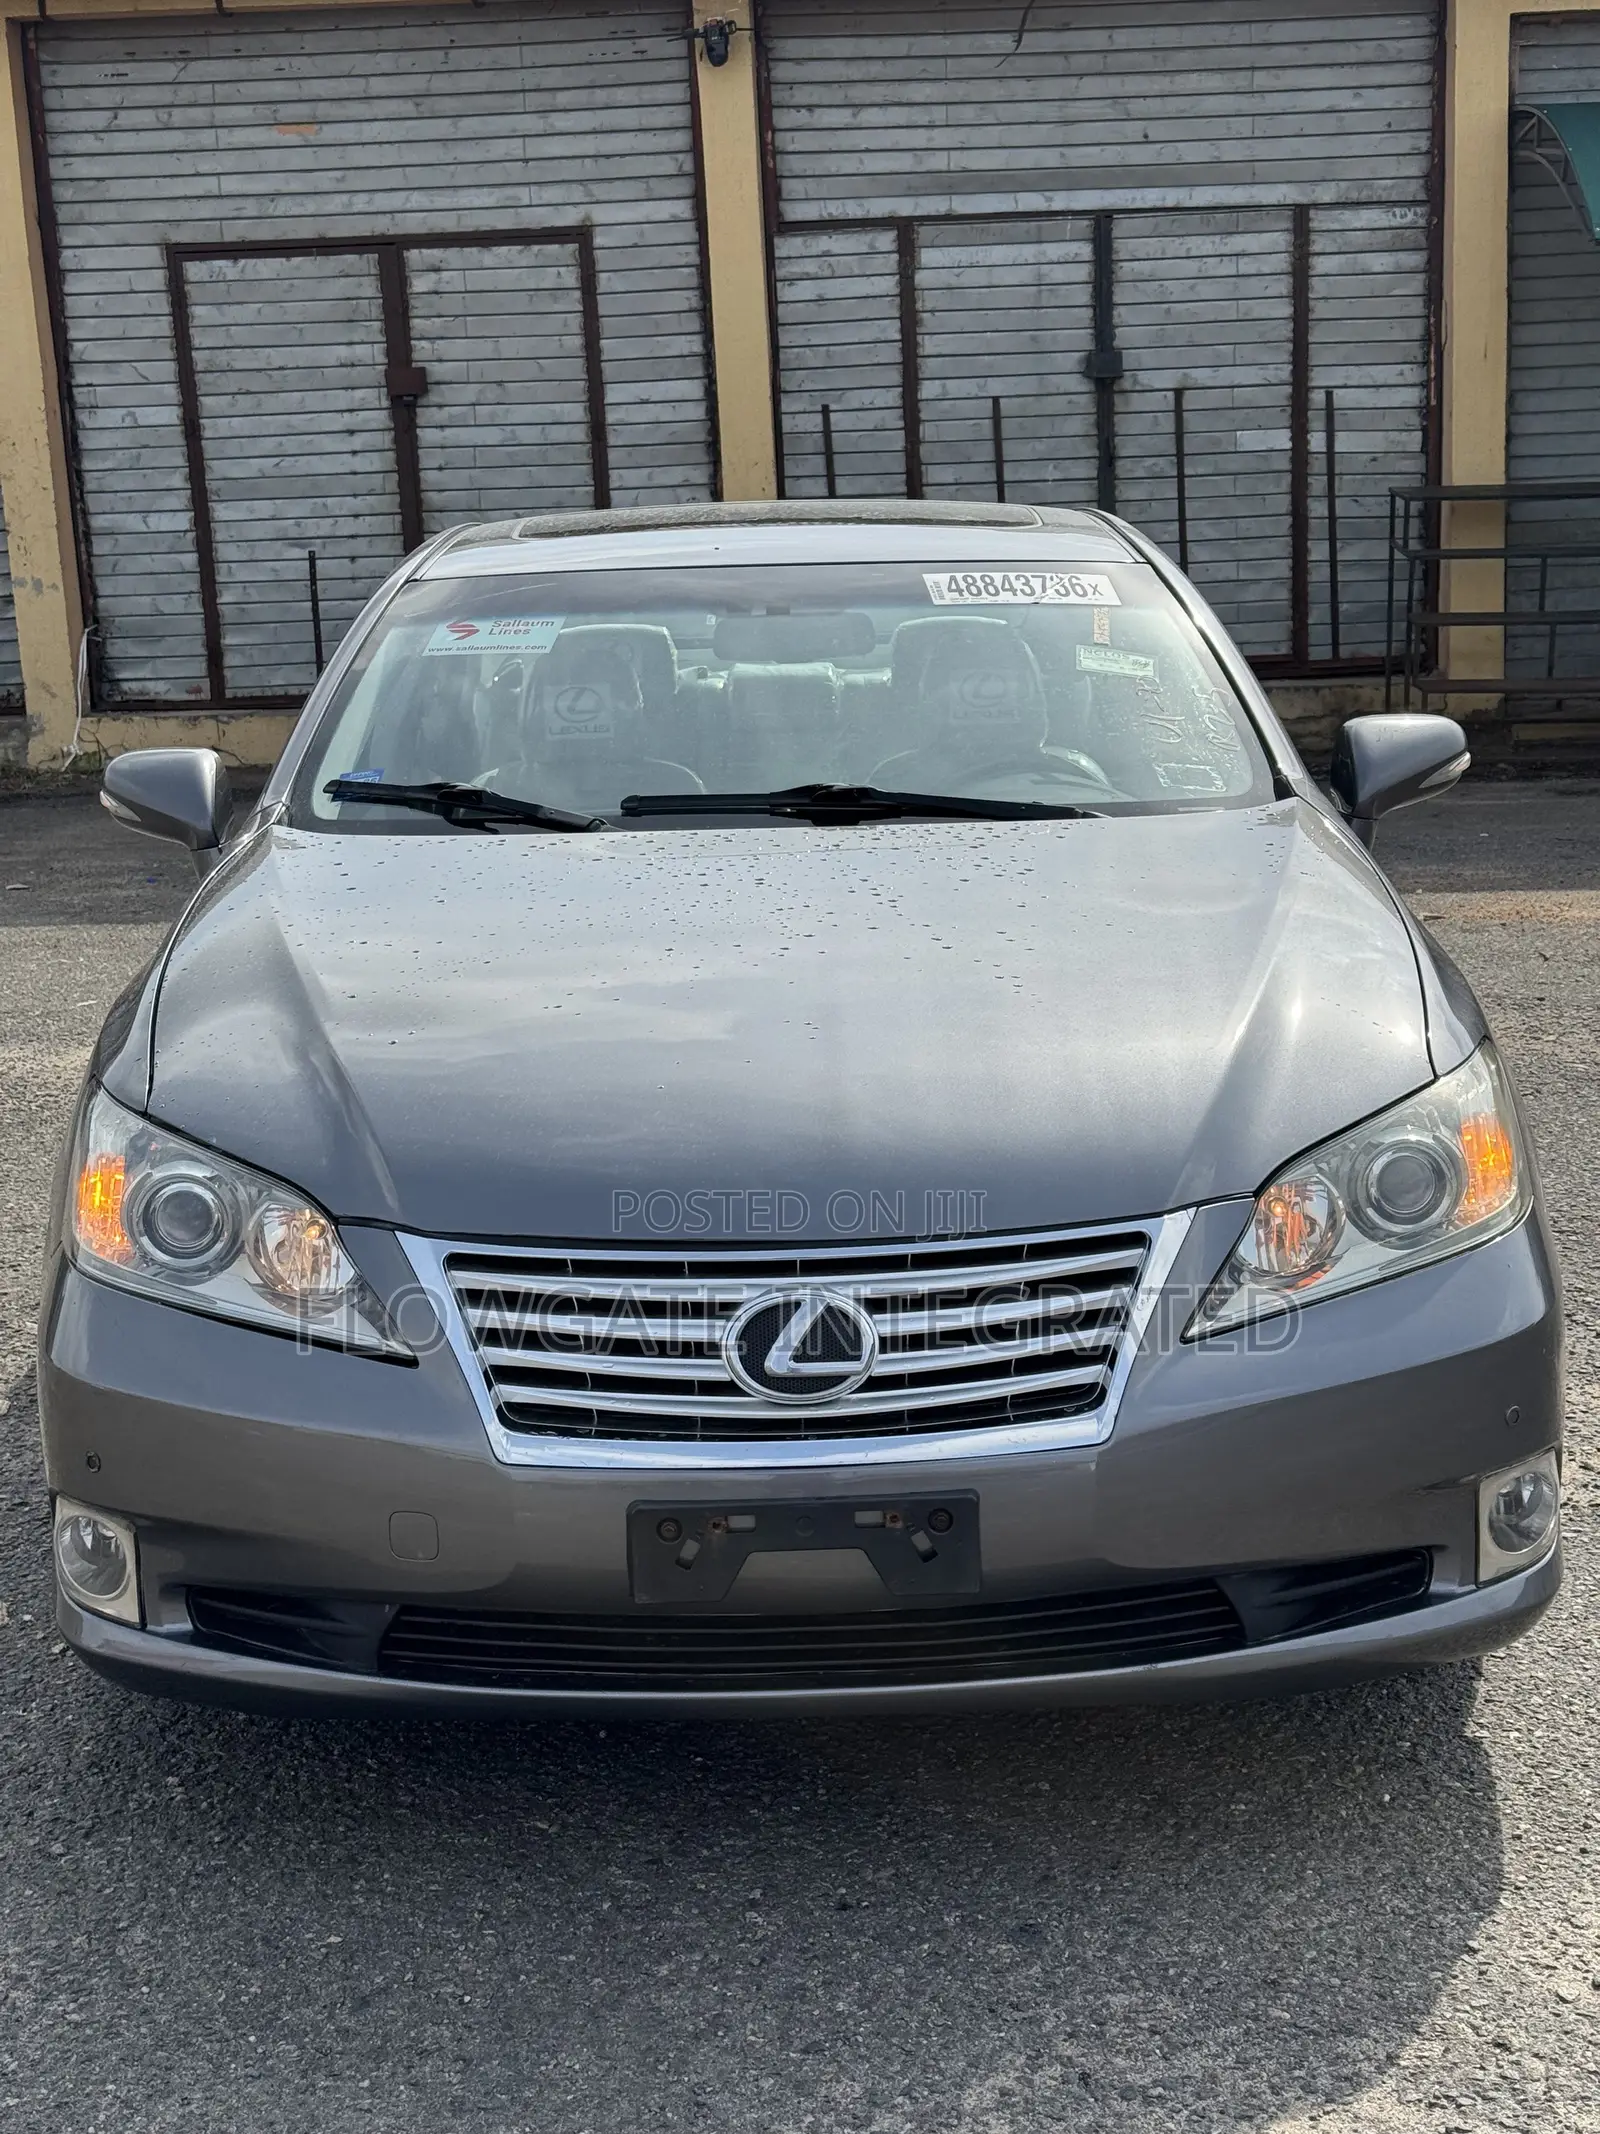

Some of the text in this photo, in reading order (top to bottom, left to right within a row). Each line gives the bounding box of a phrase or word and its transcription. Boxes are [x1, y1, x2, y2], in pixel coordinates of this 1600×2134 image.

[491, 619, 555, 628] Sallaum
[488, 628, 531, 636] Lines
[428, 644, 548, 653] www.sallaumlines.com
